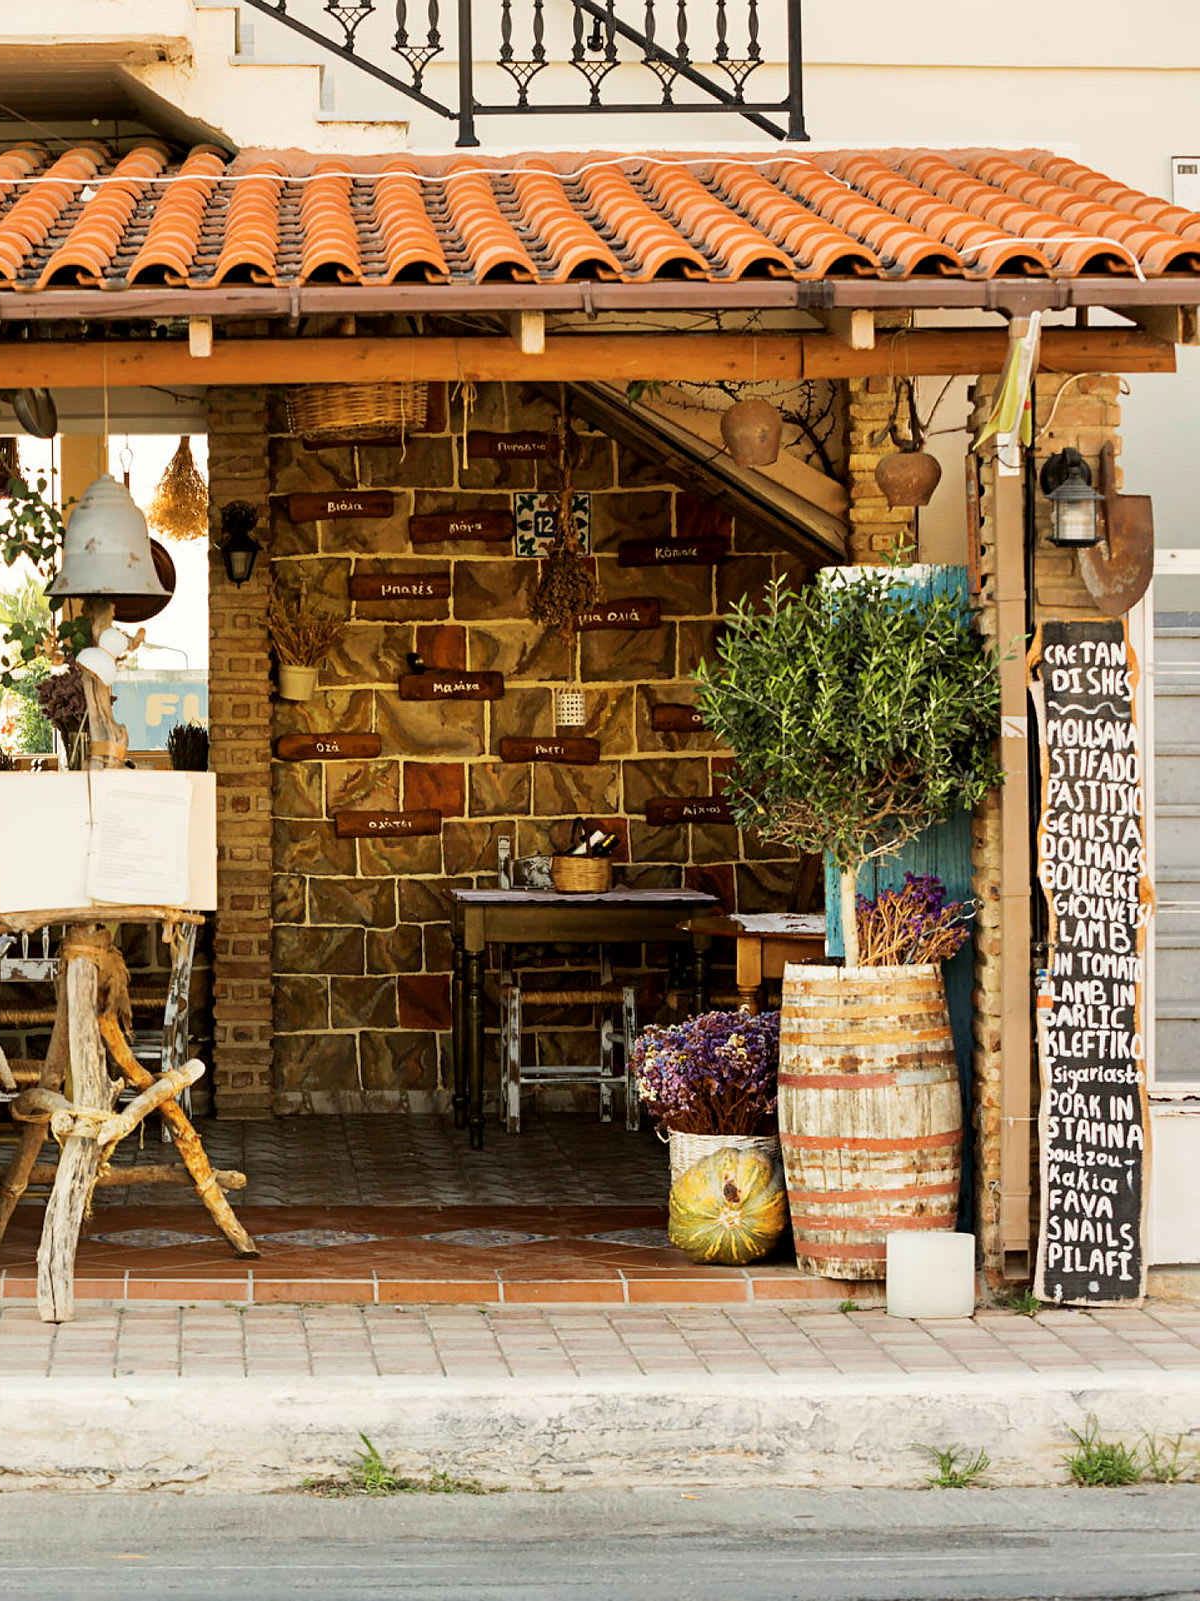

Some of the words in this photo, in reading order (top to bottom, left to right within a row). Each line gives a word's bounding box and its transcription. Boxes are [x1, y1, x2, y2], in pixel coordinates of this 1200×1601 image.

[1045, 641, 1125, 666] CRETAN
[1047, 718, 1137, 750] MOUSAKA
[1049, 748, 1140, 784] STIFADO
[1047, 779, 1143, 817] PASTITSIO
[1042, 809, 1142, 846] GEMISTA
[1041, 833, 1146, 878] DOLMADES
[1040, 859, 1138, 903] BOUREKI
[1053, 894, 1153, 929] GIOUVETSI
[1059, 920, 1131, 953] LAMB
[1053, 952, 1072, 976] IN
[1077, 951, 1142, 983] TOMATO
[1049, 980, 1107, 1005] LAMB
[1113, 983, 1135, 1007] IN
[1043, 1030, 1143, 1060] KLEFTIKO
[1041, 1056, 1145, 1095] Tsigariasto
[1045, 1088, 1101, 1120] PORK
[1109, 1095, 1133, 1121] IN
[1047, 1115, 1143, 1151] STAMNA
[1050, 1190, 1113, 1219] FAVA
[1048, 1216, 1134, 1251] SNAILS
[1048, 1243, 1133, 1280] PILAFI
